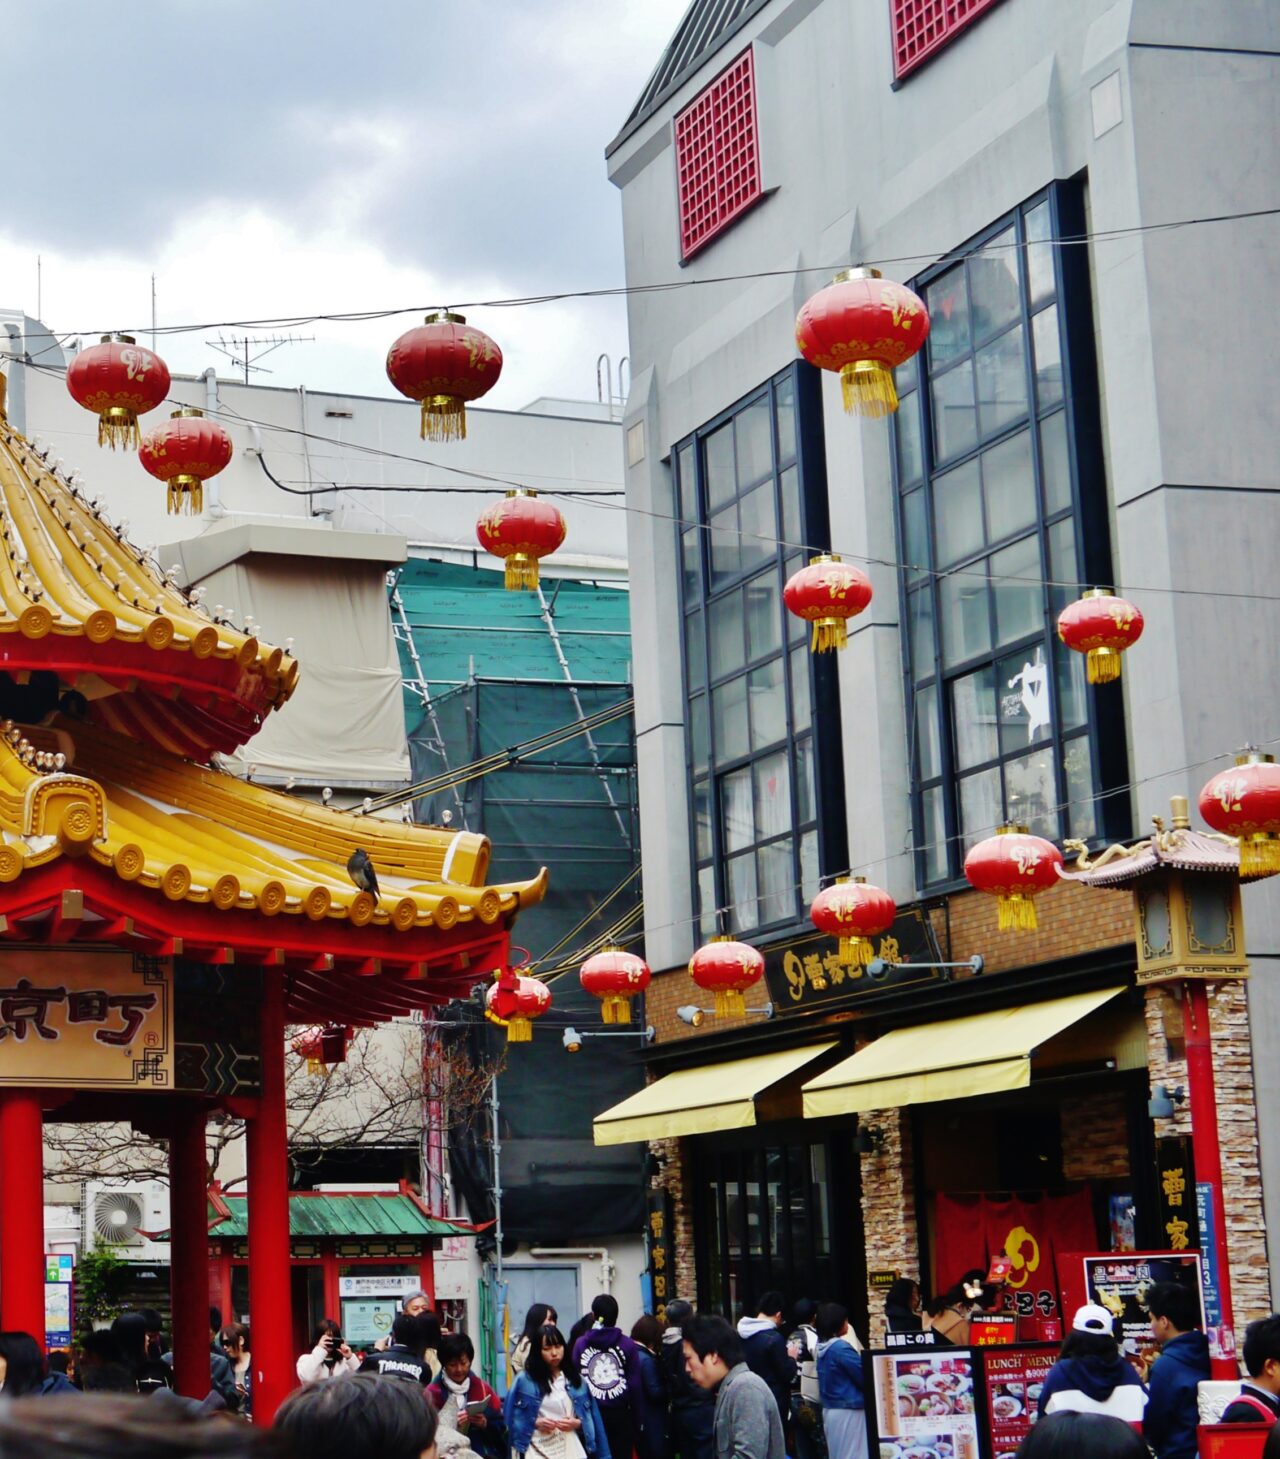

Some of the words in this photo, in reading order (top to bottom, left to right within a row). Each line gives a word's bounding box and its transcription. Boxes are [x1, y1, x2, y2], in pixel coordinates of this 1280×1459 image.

[378, 1359, 422, 1380] THRASHER
[987, 1359, 1022, 1369] LUNCH
[1027, 1356, 1057, 1366] MENU
